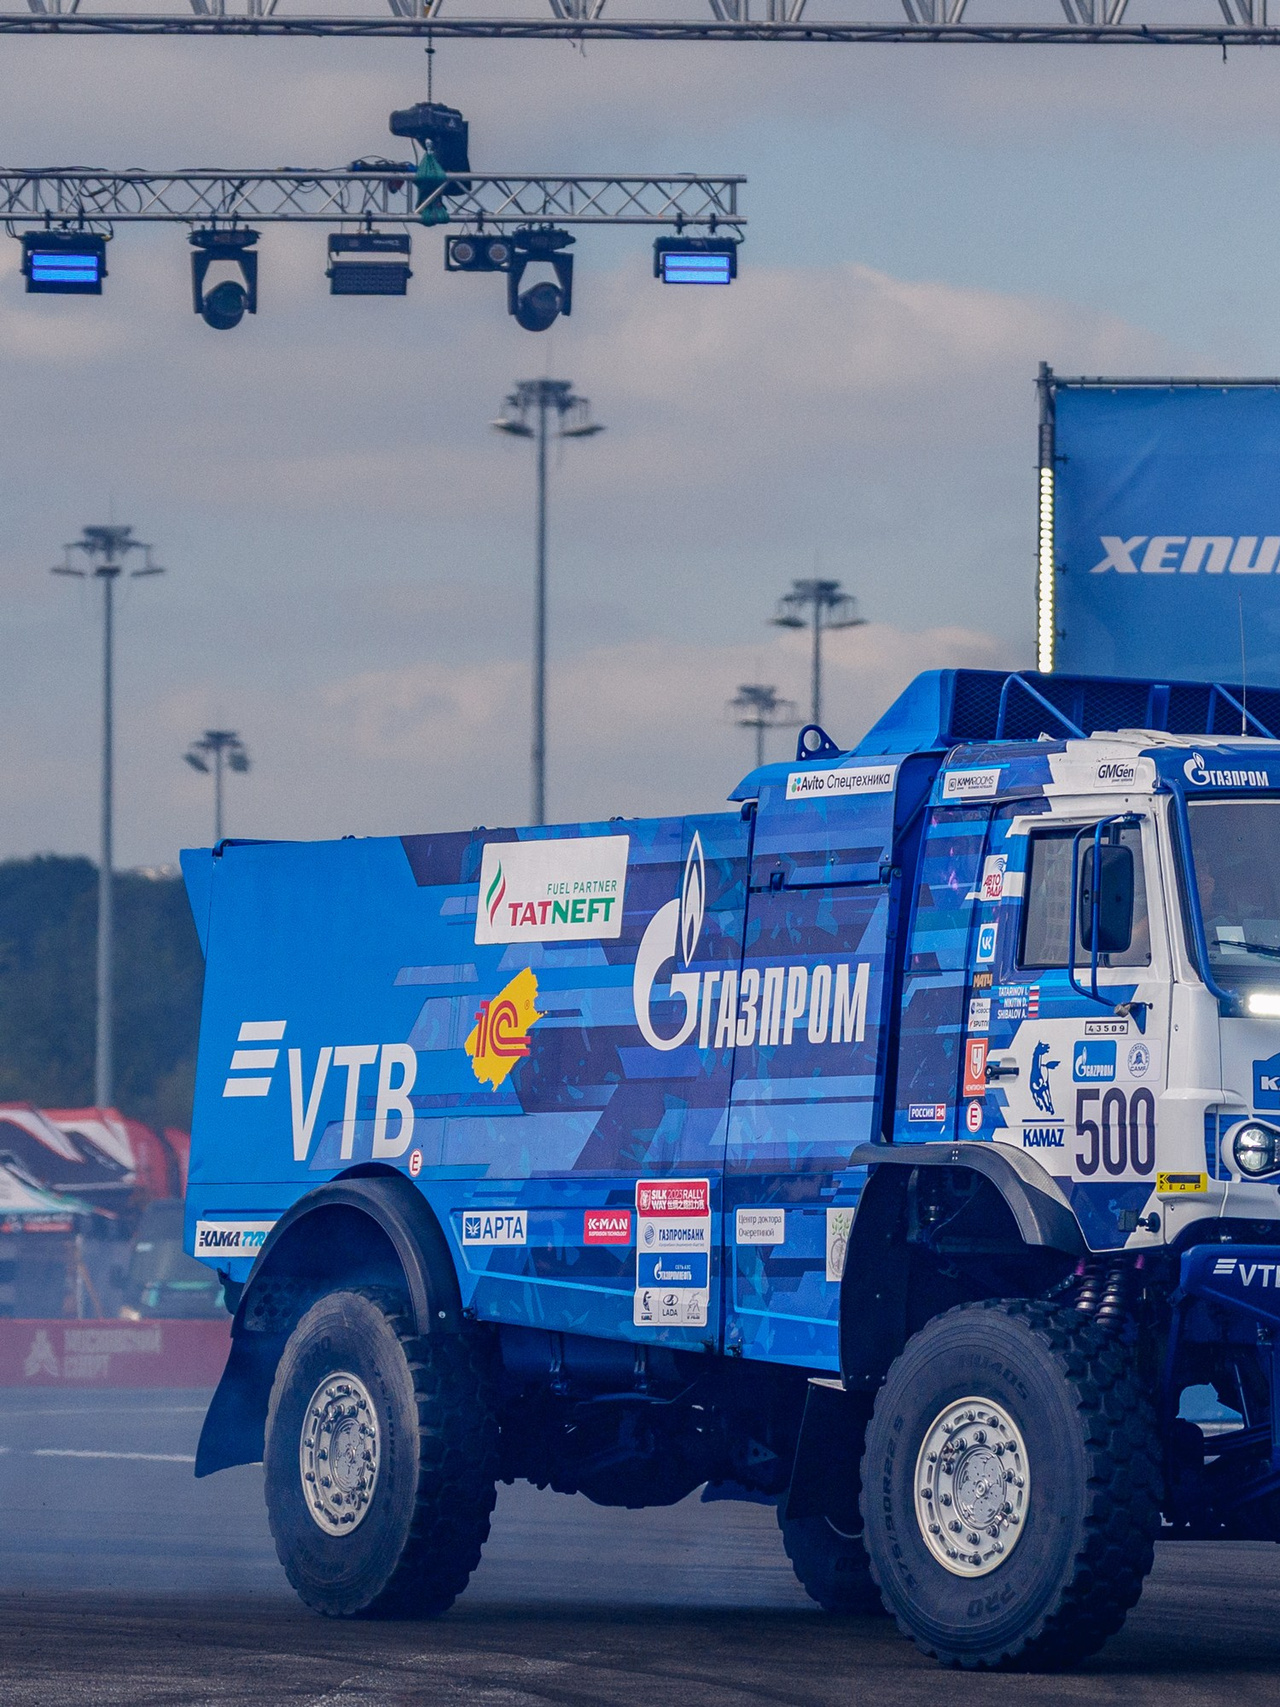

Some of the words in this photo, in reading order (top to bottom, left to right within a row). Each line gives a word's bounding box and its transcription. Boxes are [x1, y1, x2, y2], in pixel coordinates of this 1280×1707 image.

[801, 775, 825, 791] Avito
[827, 773, 890, 790] Спецтехника
[1210, 770, 1269, 787] ГАЗПРОМ
[547, 883, 570, 895] FUEL
[573, 880, 617, 894] PARTNER
[508, 897, 616, 927] TATNEFT
[699, 963, 870, 1049] ГАЗПРОМ
[288, 1043, 418, 1161] VTB
[911, 1108, 934, 1118] РОССИЯ
[936, 1107, 945, 1117] 24
[1023, 1129, 1065, 1147] KAMAZ
[1075, 1087, 1156, 1175] 500
[651, 1189, 667, 1200] SILK
[682, 1188, 705, 1199] RALLY
[738, 1214, 758, 1226] Центр
[758, 1215, 782, 1226] доктора
[199, 1230, 241, 1247] KAMA
[242, 1230, 270, 1247] TYR
[659, 1229, 705, 1241] ГАЗПРОМБАНК
[662, 1309, 678, 1317] LADA
